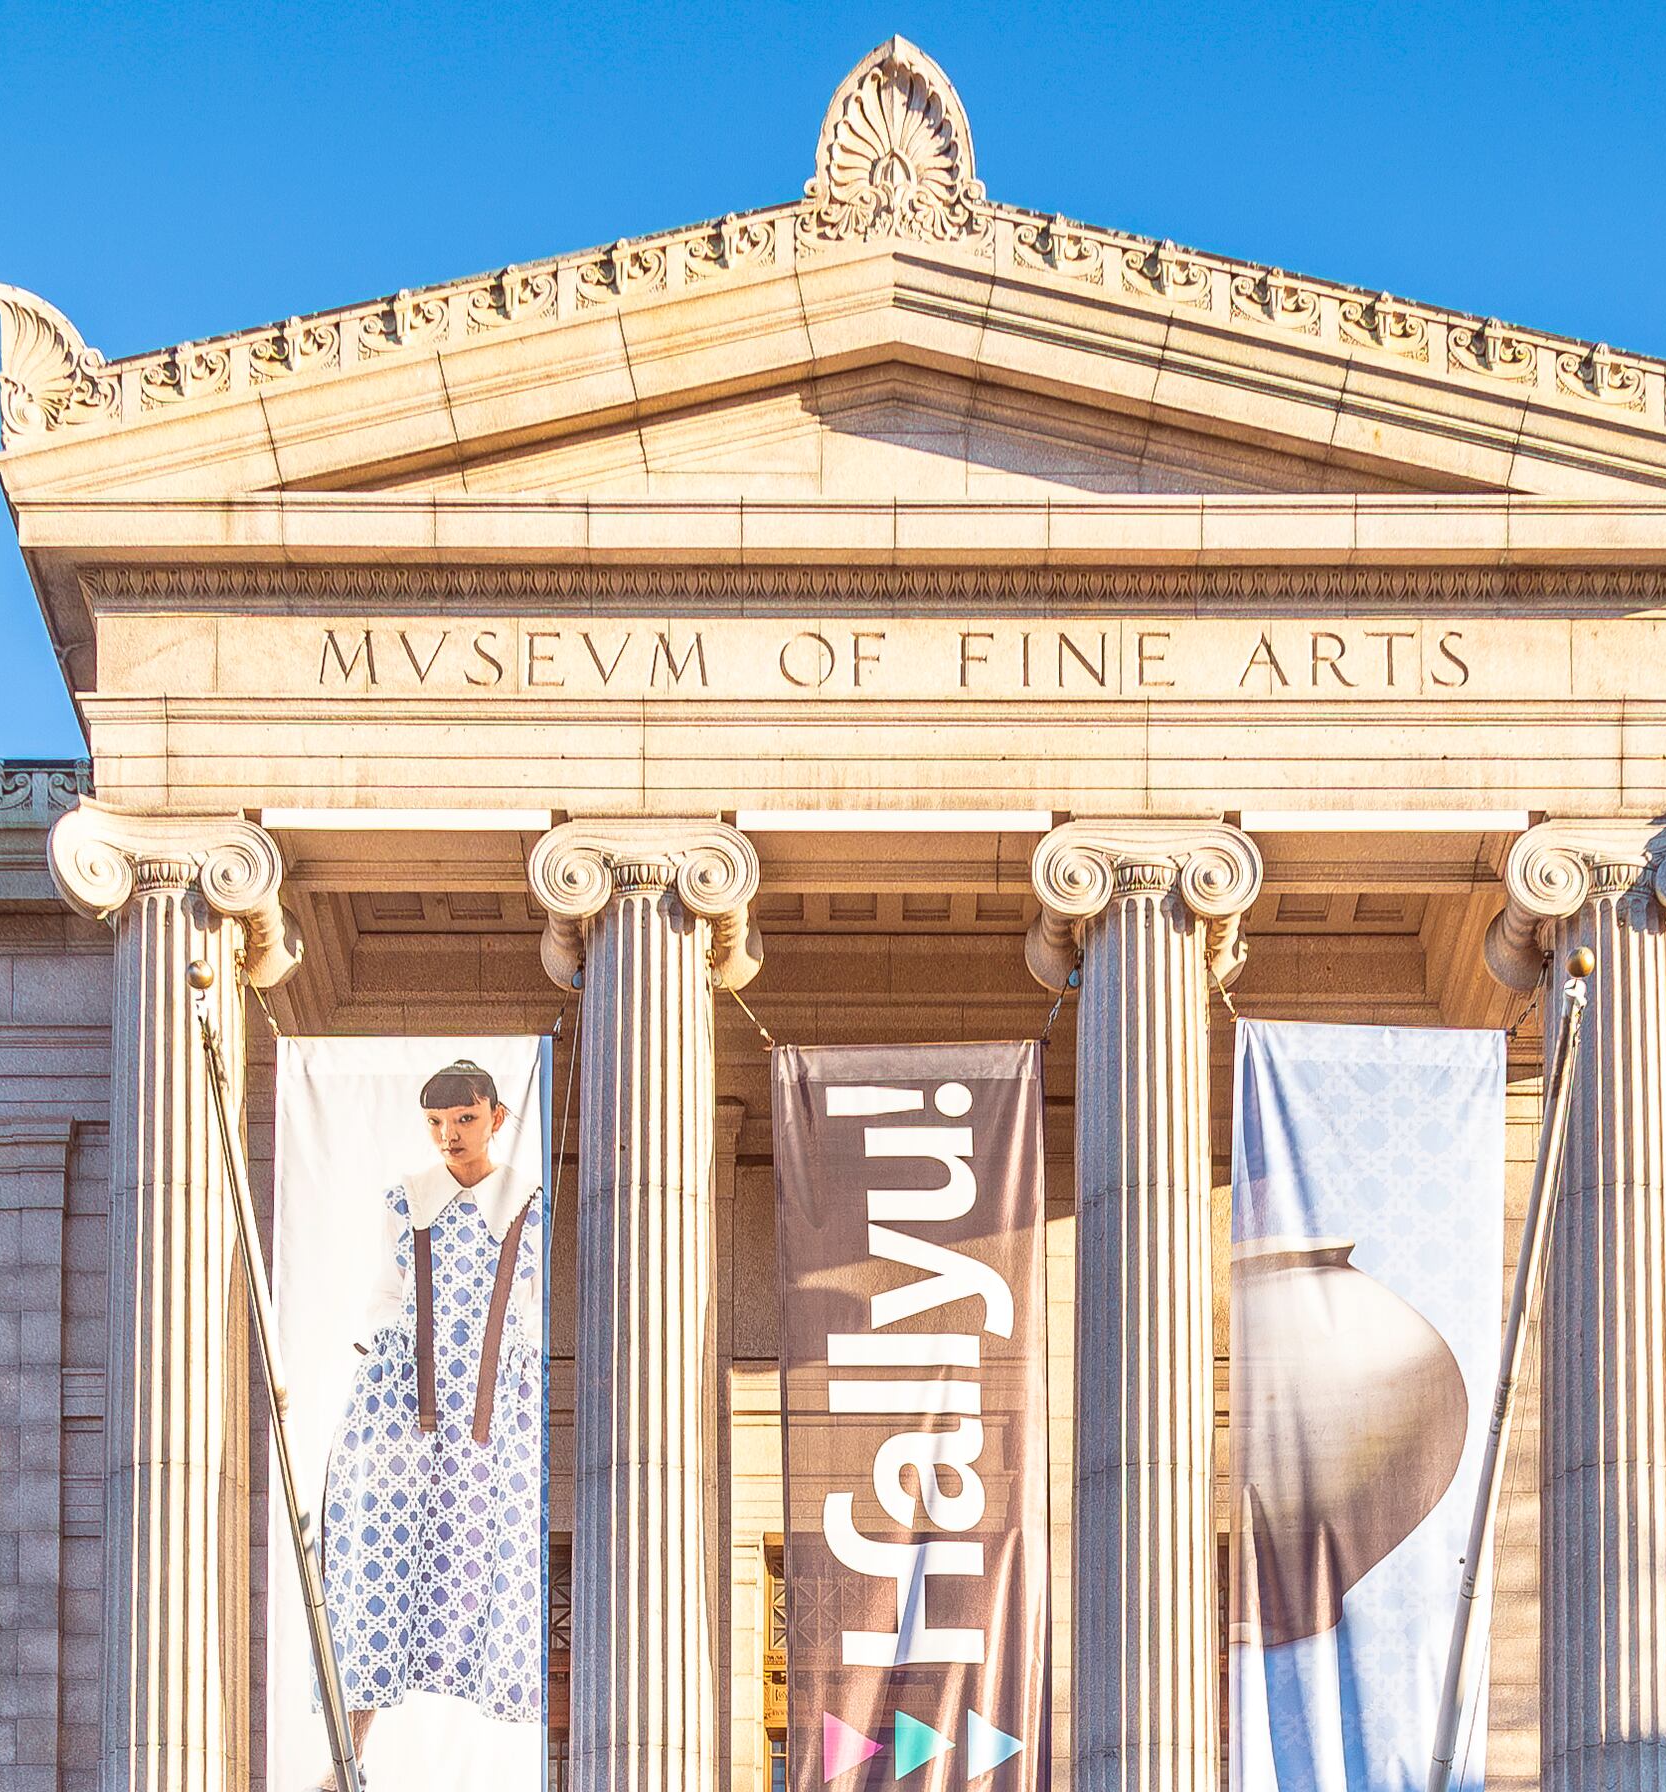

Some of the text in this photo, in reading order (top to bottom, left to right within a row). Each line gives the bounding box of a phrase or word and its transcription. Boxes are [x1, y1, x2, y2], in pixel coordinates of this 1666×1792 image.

[318, 629, 1470, 688] MVSEVM OF FINE ARTS
